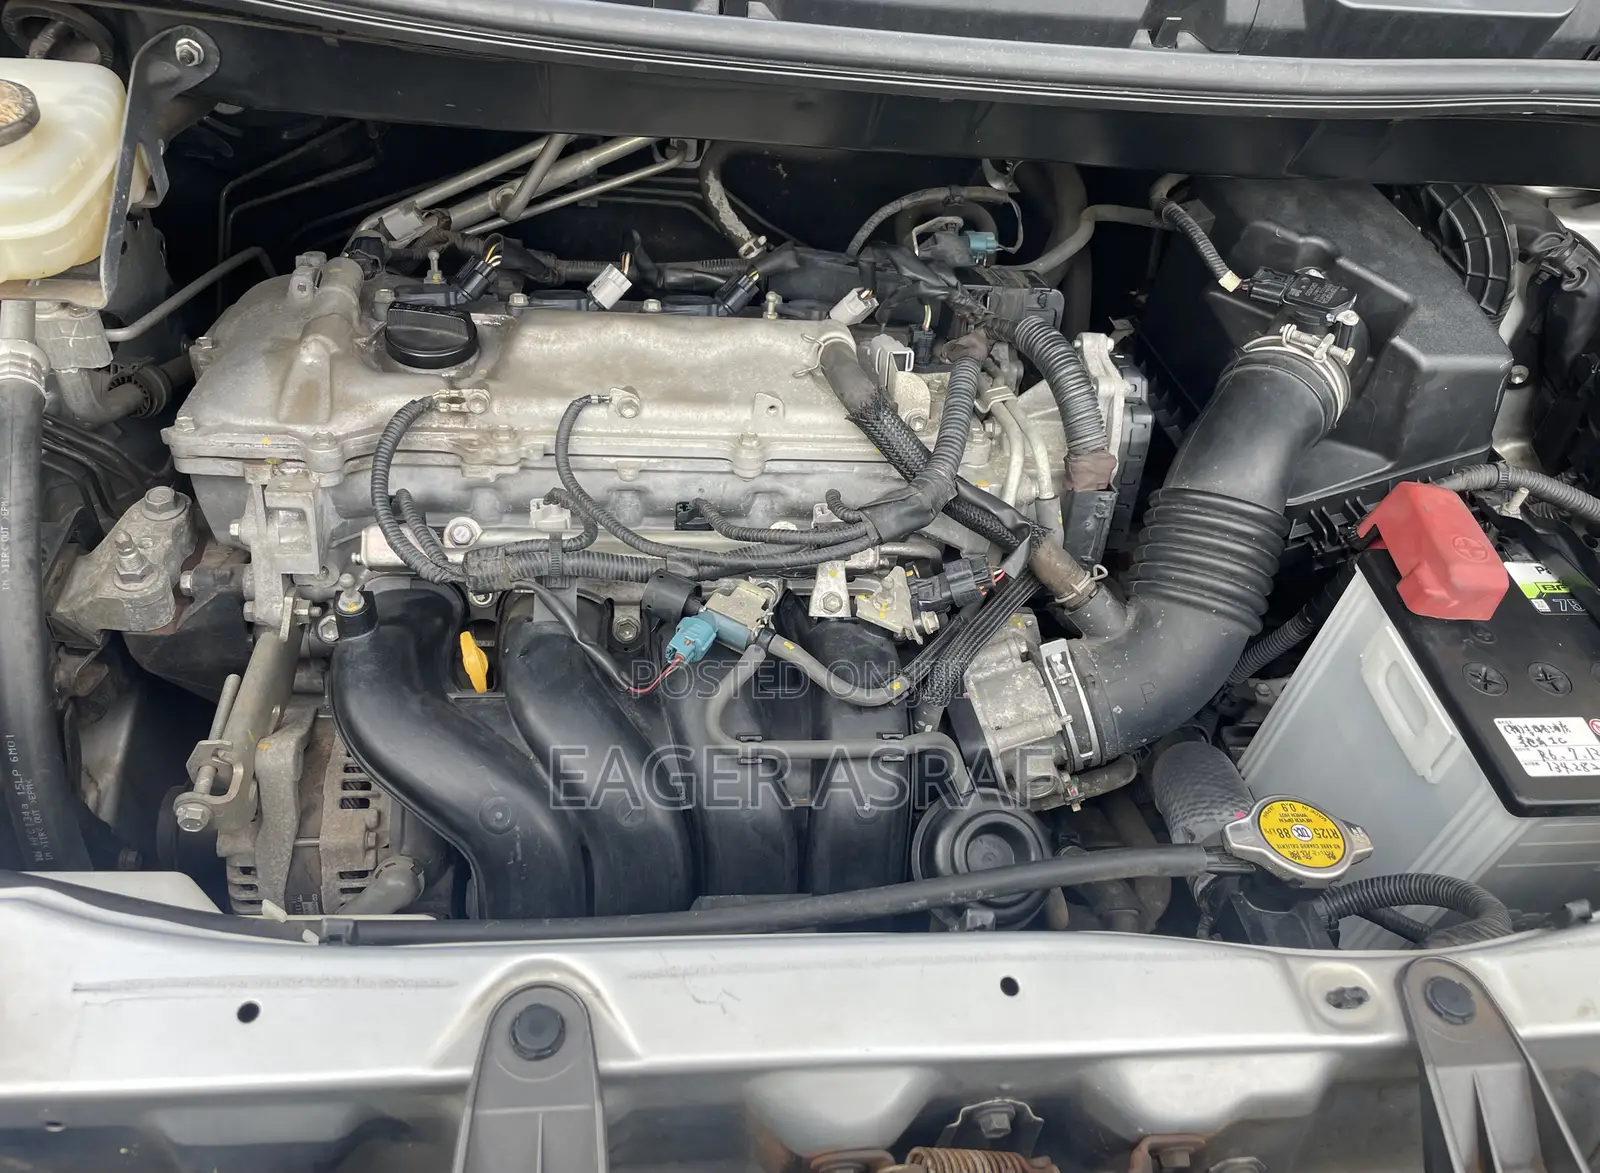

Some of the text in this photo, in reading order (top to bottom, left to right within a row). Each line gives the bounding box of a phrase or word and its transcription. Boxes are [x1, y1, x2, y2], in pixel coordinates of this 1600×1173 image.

[1, 526, 9, 542] OUT
[2, 579, 10, 590] IN
[1139, 681, 1156, 704] P
[1263, 805, 1275, 818] JAPAN
[1281, 803, 1297, 813] 0.9
[31, 809, 42, 824] OUT
[1276, 827, 1291, 839] 88
[1313, 827, 1340, 839] R125
